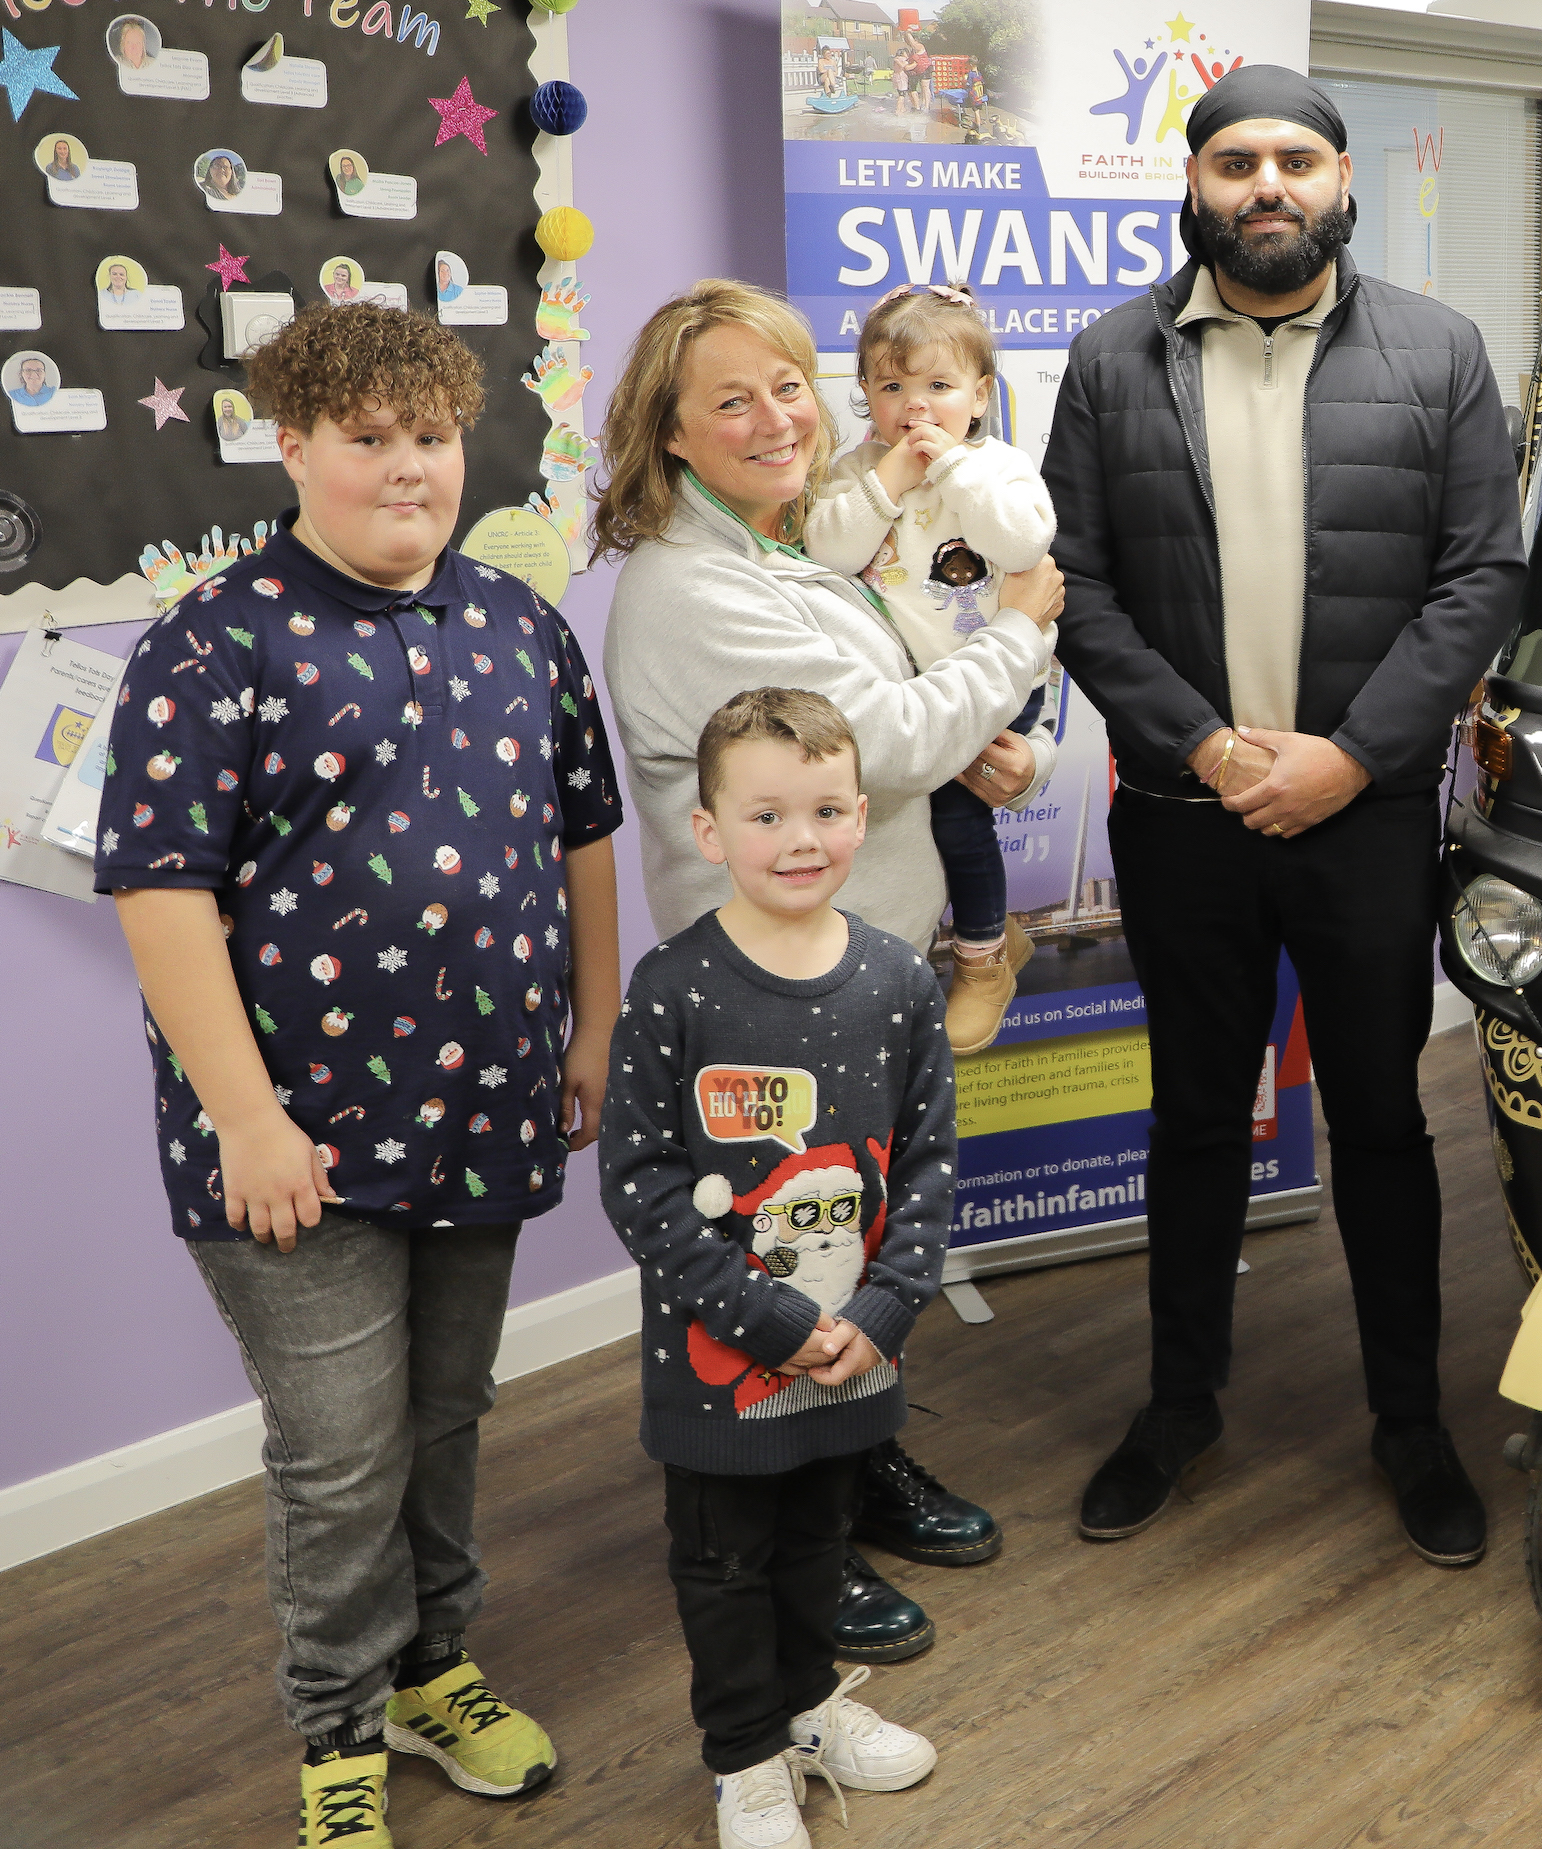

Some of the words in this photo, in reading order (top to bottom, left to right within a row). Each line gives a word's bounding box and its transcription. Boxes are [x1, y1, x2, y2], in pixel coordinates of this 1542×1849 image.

[932, 160, 1022, 190] MAKE
[1078, 170, 1139, 180] BUILDING
[1145, 172, 1185, 181] BRIGH
[1082, 154, 1143, 167] FAITH
[1153, 156, 1172, 168] IN
[837, 205, 1186, 288] SWANS
[839, 309, 863, 336] A
[1066, 308, 1110, 334] FO
[1036, 370, 1061, 384] The
[483, 543, 510, 551] Everyone
[1016, 803, 1062, 823] their
[999, 1013, 1021, 1029] nd
[1025, 1014, 1041, 1025] us
[1044, 1012, 1063, 1023] on
[1066, 1001, 1107, 1020] Social
[1110, 995, 1147, 1013] Medi
[955, 1080, 974, 1094] lief
[976, 1079, 994, 1091] for
[996, 1072, 1046, 1089] children
[1049, 1067, 1072, 1080] and
[1074, 1060, 1120, 1076] families
[1123, 1058, 1134, 1069] in
[956, 1063, 982, 1078] ised
[984, 1061, 1001, 1074] for
[1005, 1056, 1034, 1070] Faith
[1037, 1054, 1049, 1066] in
[1052, 1047, 1099, 1064] Families
[752, 1075, 788, 1103] YO
[956, 1100, 971, 1111] re
[974, 1094, 1008, 1107] living
[1010, 1086, 1060, 1103] through
[1062, 1079, 1109, 1095] trauma,
[1110, 1074, 1140, 1087] crisis
[956, 1116, 977, 1127] ess.
[955, 1169, 1023, 1190] ormation
[1025, 1165, 1042, 1178] or
[1043, 1162, 1059, 1176] to
[1062, 1153, 1115, 1173] donate,
[1117, 1148, 1150, 1167] plea
[952, 1173, 1146, 1233] .faithinfamil
[1250, 1159, 1280, 1181] es
